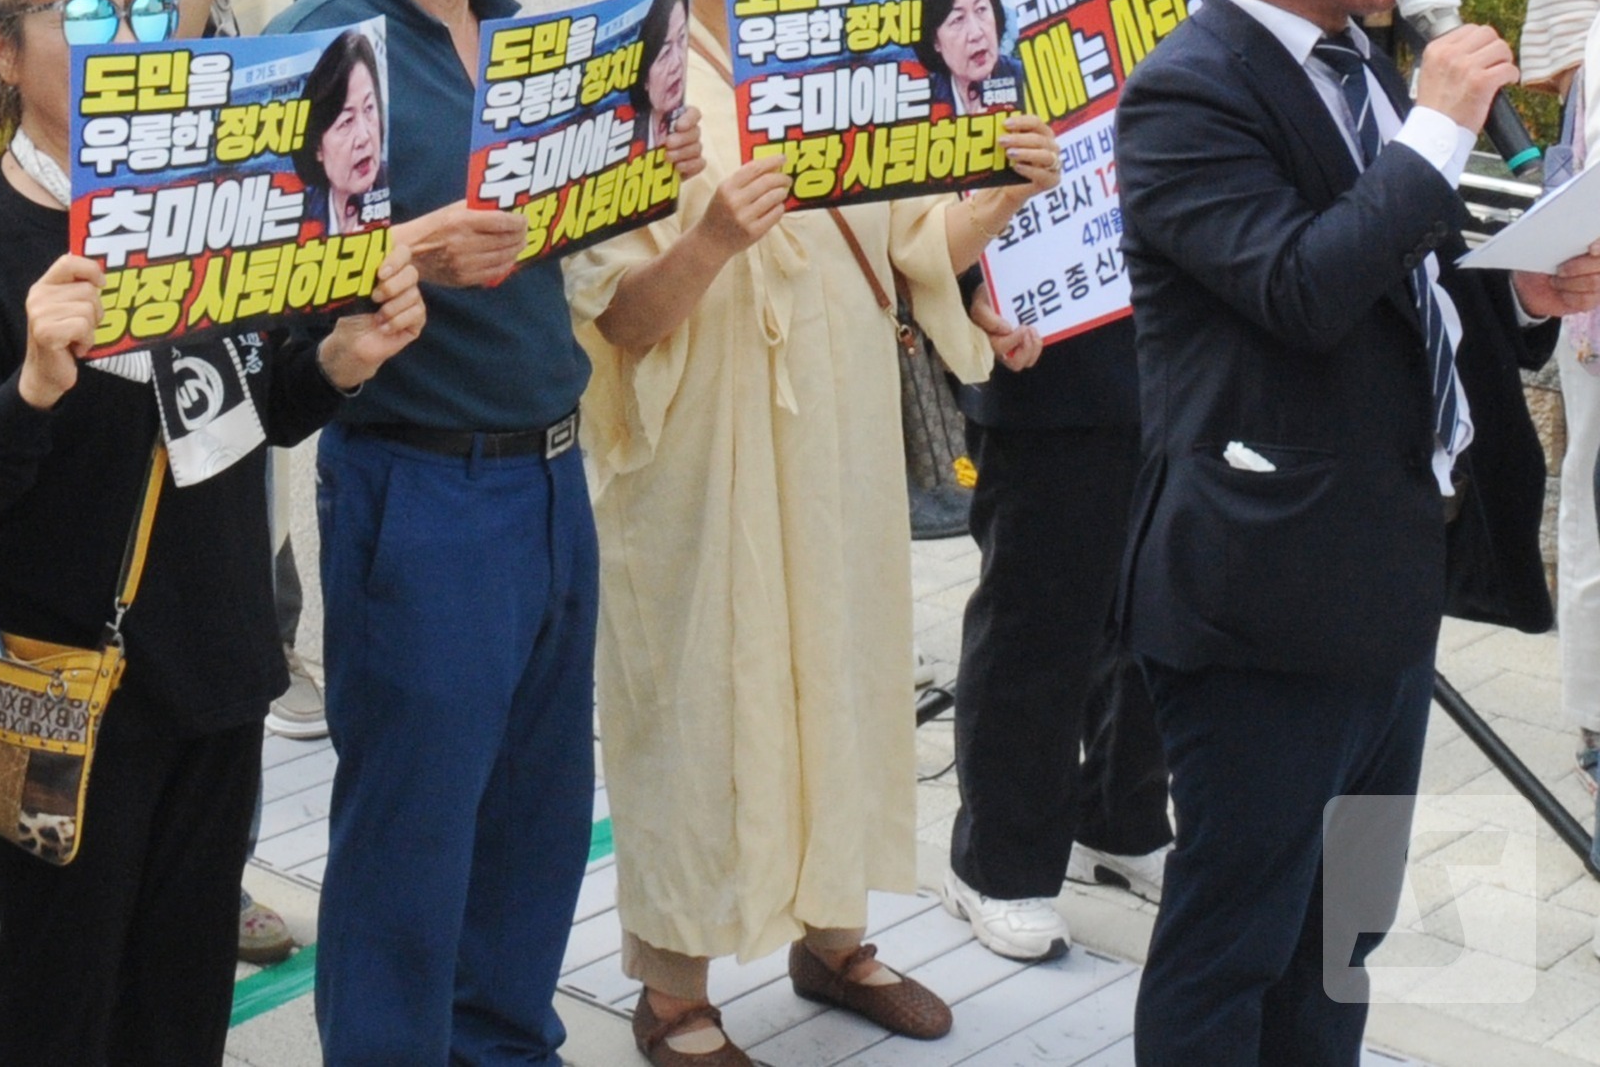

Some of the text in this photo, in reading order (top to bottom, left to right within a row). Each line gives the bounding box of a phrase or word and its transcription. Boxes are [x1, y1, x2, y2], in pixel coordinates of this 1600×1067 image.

[485, 15, 598, 81] 도민을
[737, 11, 842, 65] 우롱한
[79, 49, 232, 115] 도민을
[481, 39, 645, 130] 우롱한 정치!
[747, 61, 932, 140] 추미애는
[79, 108, 215, 175] 우롱한
[214, 98, 311, 162] 정치!
[478, 108, 636, 209] 추미애는
[1059, 135, 1097, 174] 리대
[84, 173, 304, 269] 추미애는
[1045, 174, 1093, 227] 관사
[93, 259, 194, 346] 당장
[1011, 278, 1063, 327] 같은
[1064, 262, 1090, 302] 종
